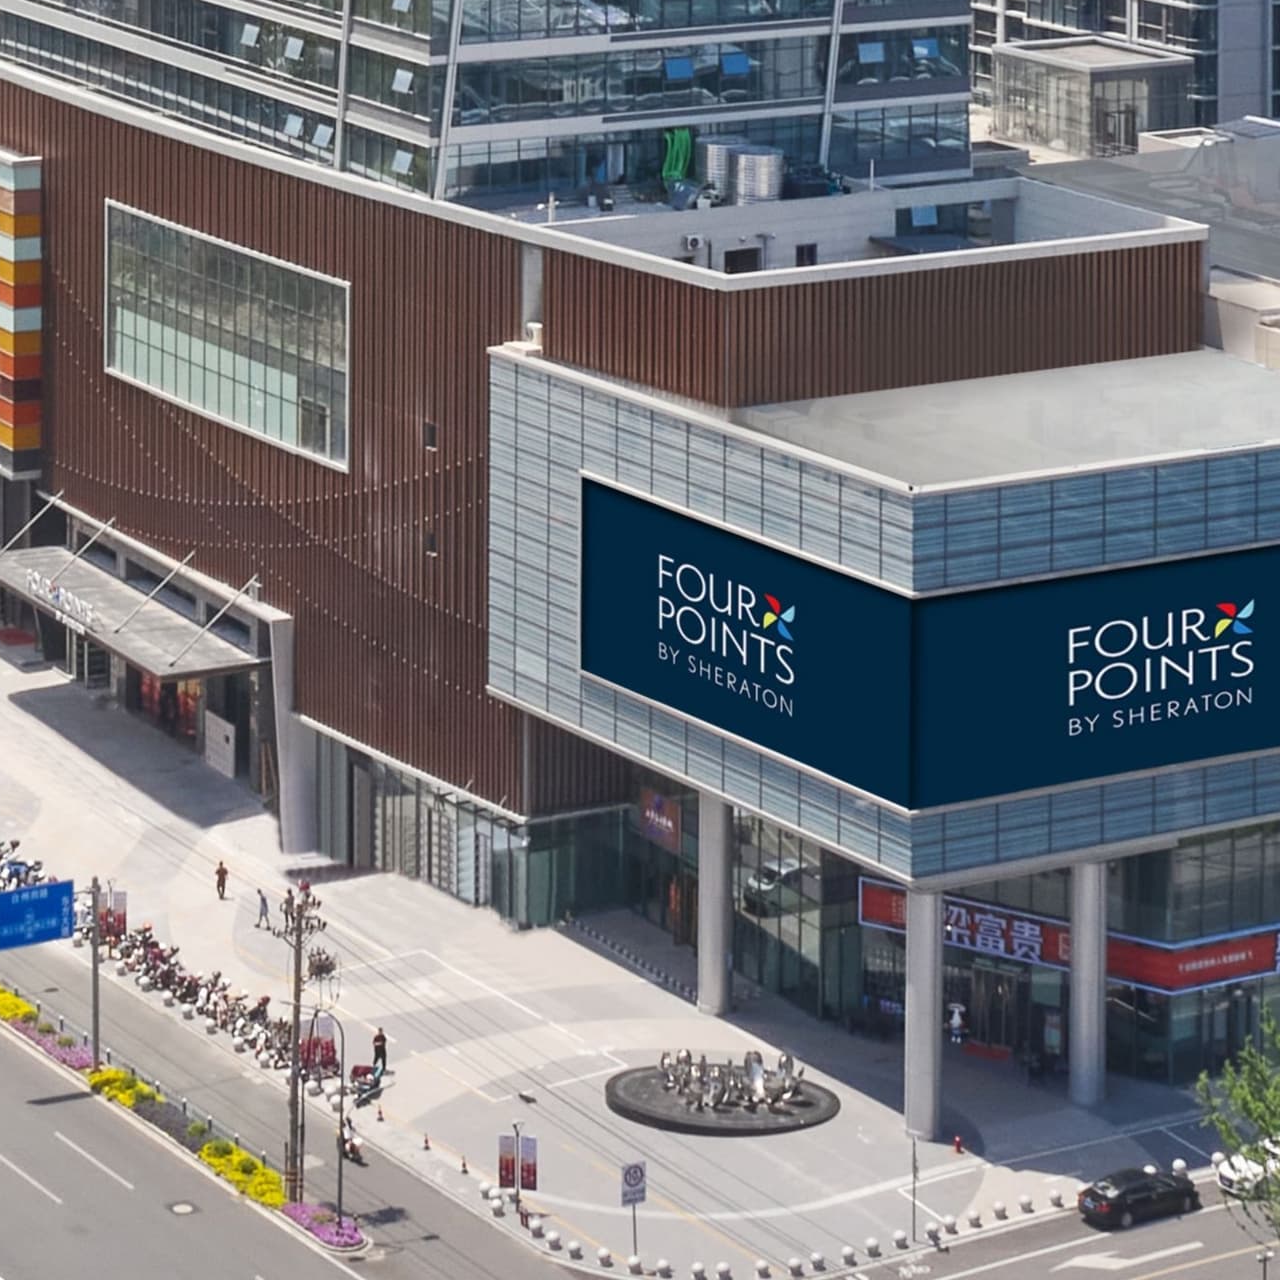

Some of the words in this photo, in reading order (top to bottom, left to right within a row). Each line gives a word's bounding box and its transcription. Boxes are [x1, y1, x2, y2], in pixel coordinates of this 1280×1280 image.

[658, 554, 761, 628] FOUR
[658, 595, 796, 686] POINTS
[1068, 608, 1211, 664] FOUR
[658, 642, 680, 665] BY
[687, 655, 794, 718] SHERATON
[1068, 640, 1255, 707] POINTS
[1068, 713, 1100, 737] BY
[1112, 687, 1253, 728] SHERATON
[943, 904, 1043, 964] 梁富贵
